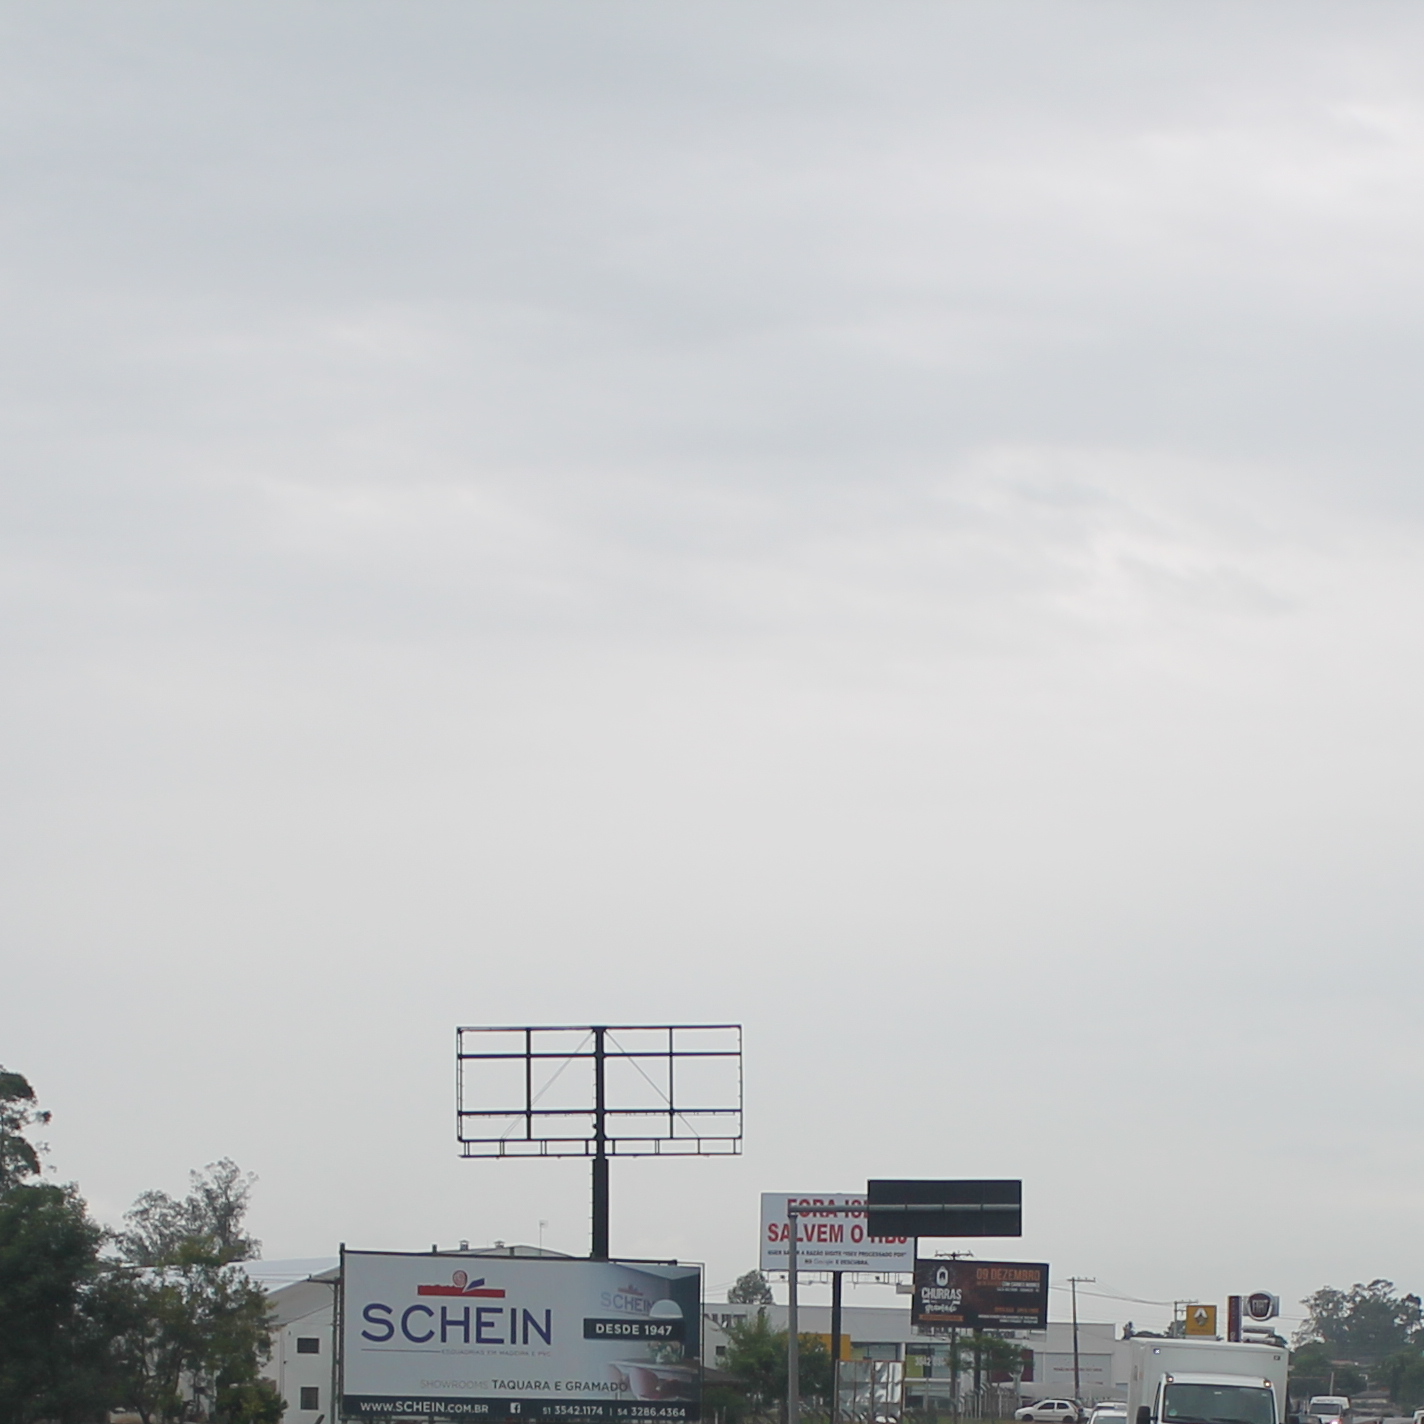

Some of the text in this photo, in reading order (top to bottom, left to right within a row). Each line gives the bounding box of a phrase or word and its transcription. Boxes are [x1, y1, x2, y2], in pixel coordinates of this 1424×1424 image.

[851, 1224, 864, 1243] O
[976, 1268, 1040, 1281] 09 DEZEMBRO
[921, 1287, 962, 1300] CHURRAS
[600, 1291, 655, 1311] SCHEIN
[361, 1303, 552, 1346] SCHEIN
[595, 1323, 673, 1336] DESDE 1947
[420, 1379, 629, 1392] SHOWROOMS TAQUARA E GRAMADO
[360, 1400, 489, 1414] WWW.SCHEIN.COM.BR
[554, 1406, 604, 1415] 3542.1174
[617, 1407, 686, 1417] 54 3286.4364
